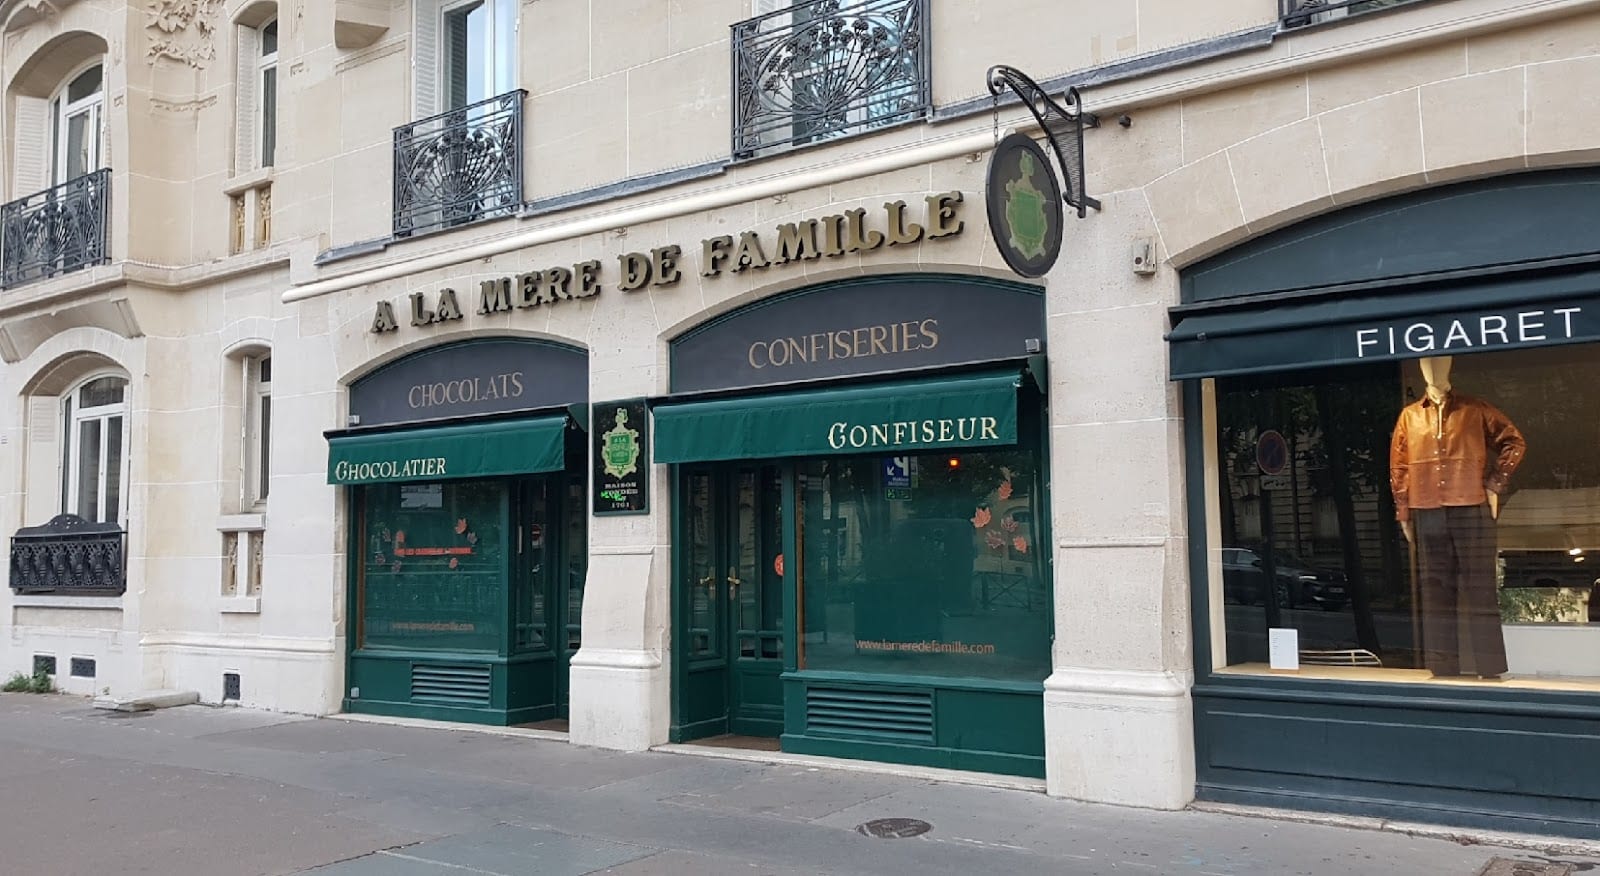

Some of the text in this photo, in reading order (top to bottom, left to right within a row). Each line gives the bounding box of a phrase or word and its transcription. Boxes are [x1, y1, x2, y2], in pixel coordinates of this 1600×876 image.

[370, 190, 966, 333] A LA MERE DE FAMILLE
[748, 318, 939, 369] CONFISERIES
[1355, 307, 1582, 358] FIGARET
[408, 371, 524, 409] CHOCOLATS
[827, 416, 1000, 450] CONFISEUR
[334, 456, 447, 481] CHOCOLATIER
[855, 638, 995, 654] www.lameredefamille.com
